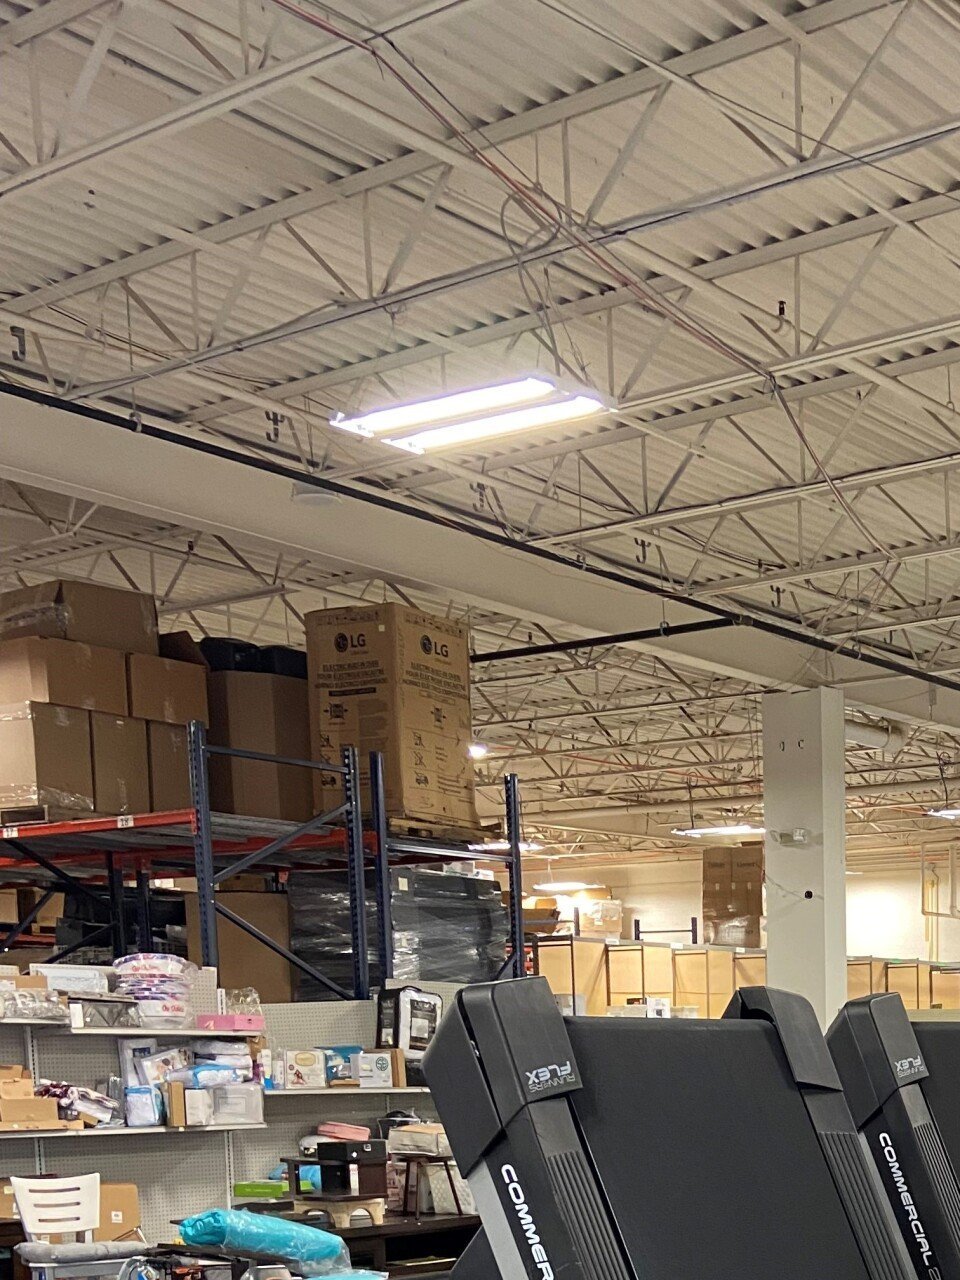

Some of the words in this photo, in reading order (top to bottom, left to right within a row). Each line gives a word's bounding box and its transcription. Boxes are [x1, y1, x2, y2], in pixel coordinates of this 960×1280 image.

[351, 634, 366, 648] LG
[434, 642, 449, 658] LG
[894, 1055, 922, 1071] FLEX
[525, 1061, 572, 1085] FLEX
[879, 1132, 933, 1266] COMMERCIAL
